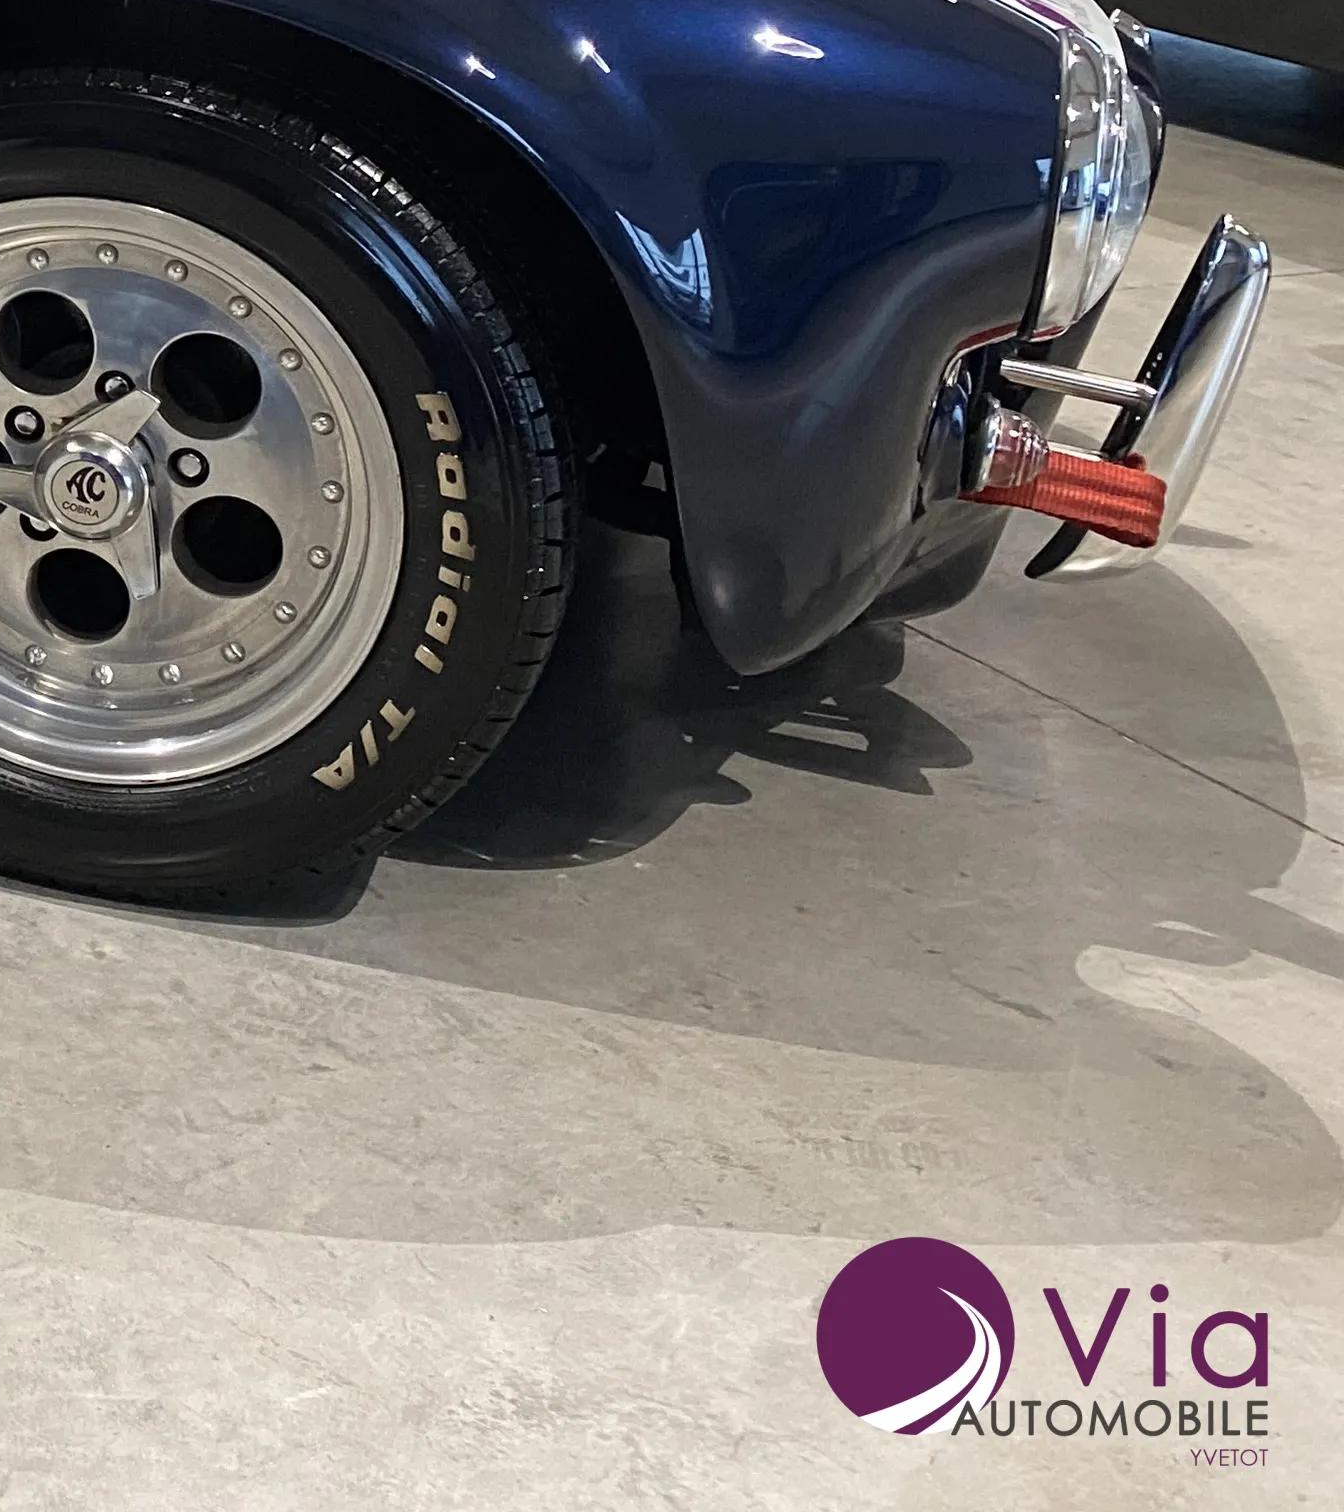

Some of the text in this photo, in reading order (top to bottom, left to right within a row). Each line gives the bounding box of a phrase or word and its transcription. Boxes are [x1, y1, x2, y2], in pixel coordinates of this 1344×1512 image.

[66, 466, 106, 504] AC
[62, 500, 100, 519] COBRA
[311, 391, 476, 791] Radial T/A
